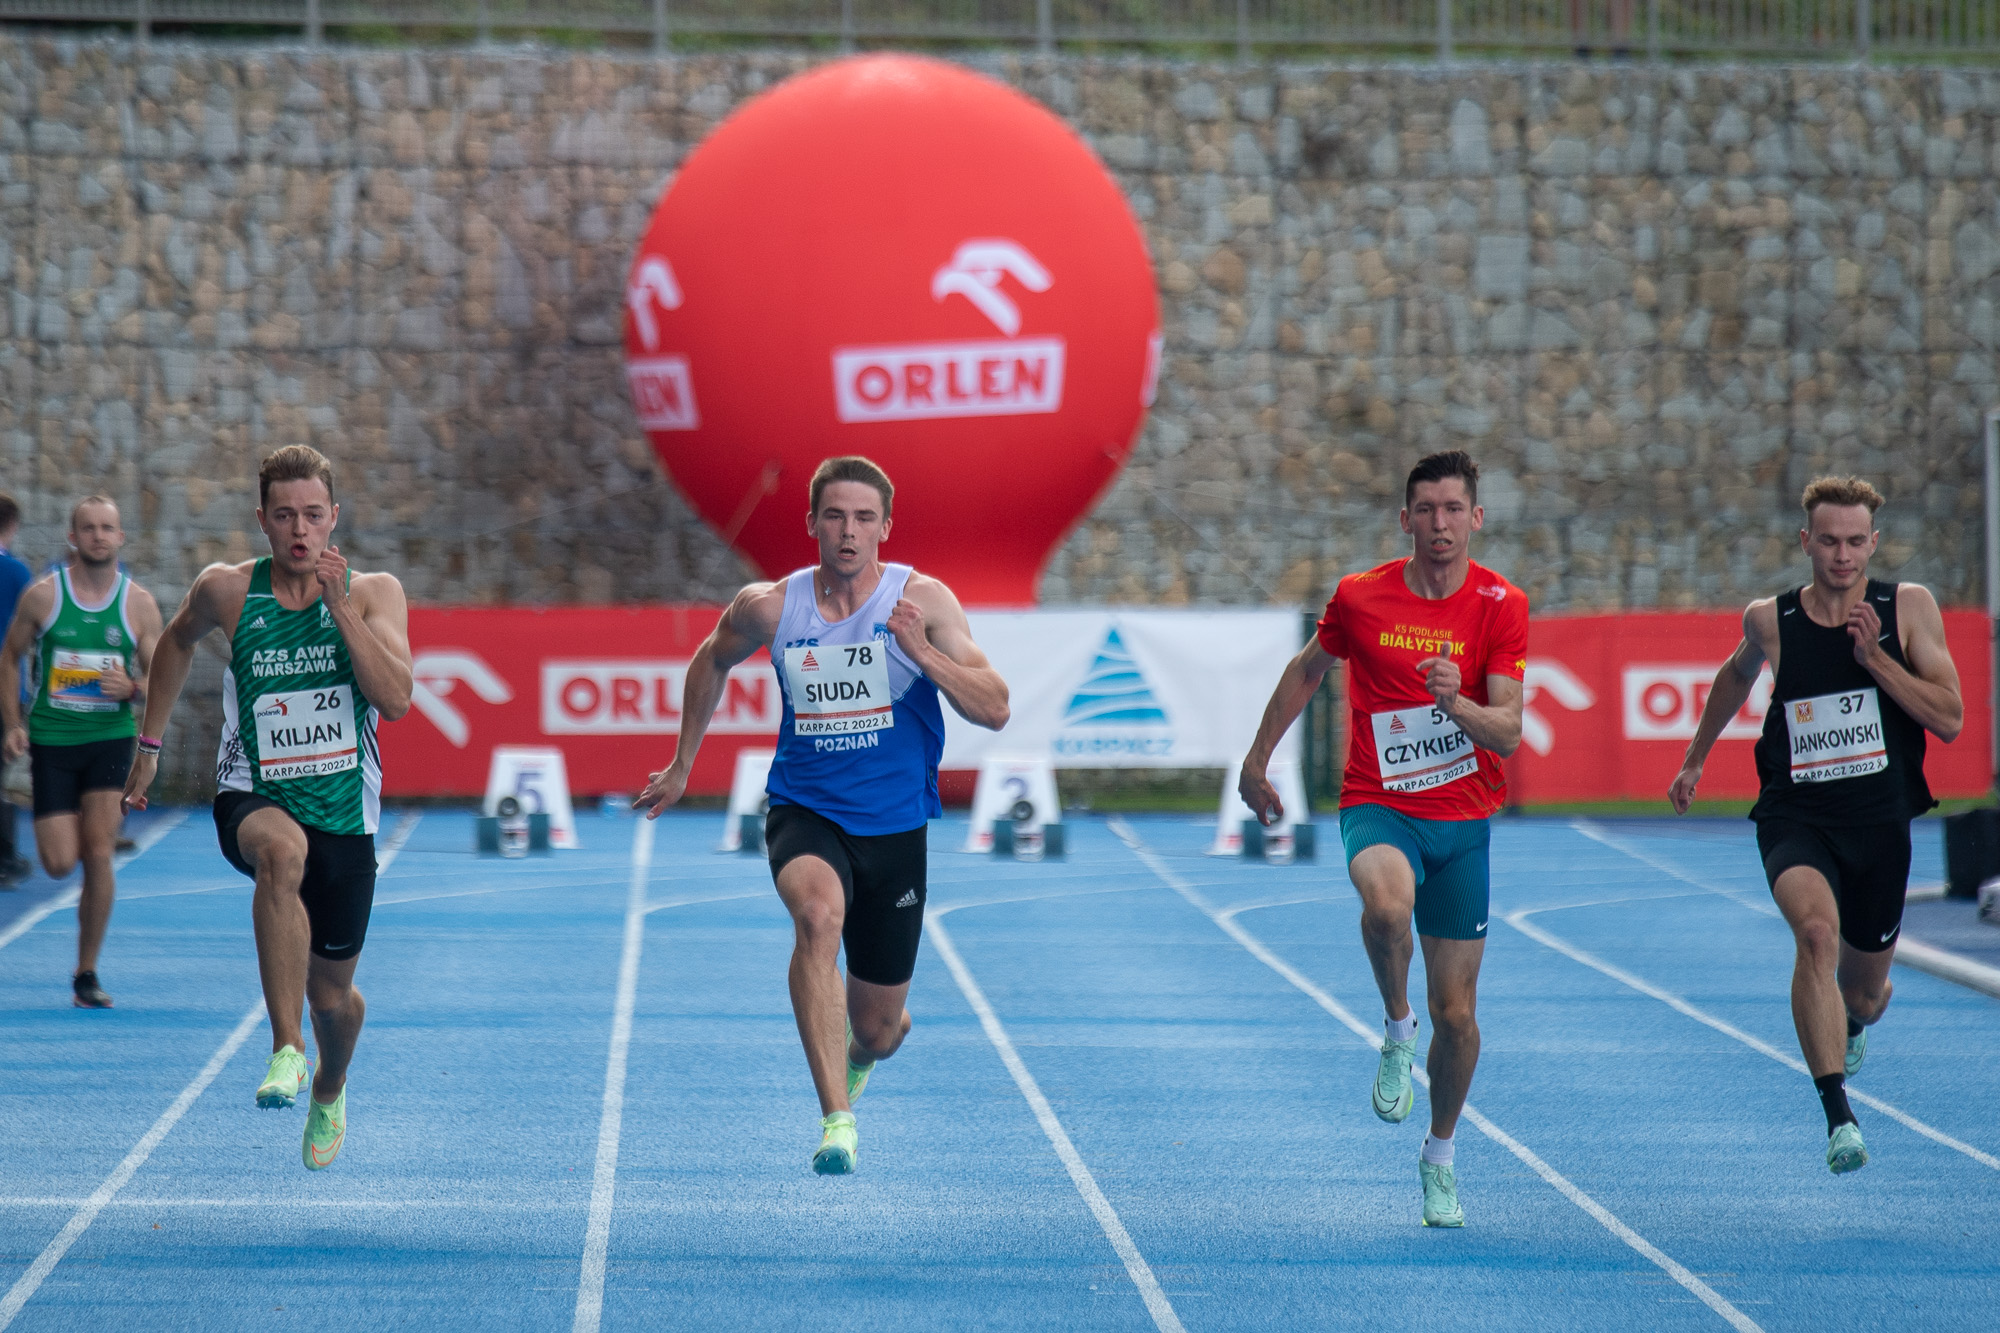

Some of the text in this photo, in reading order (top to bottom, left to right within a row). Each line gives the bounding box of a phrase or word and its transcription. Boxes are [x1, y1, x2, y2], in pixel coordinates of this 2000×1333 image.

[855, 358, 1049, 405] ORLEN
[1394, 624, 1453, 639] KS PODLASIE
[251, 645, 337, 664] AZS AWF
[844, 646, 873, 668] 78
[251, 659, 337, 678] WARSZAWA
[313, 690, 341, 712] 26
[562, 676, 768, 722] ORLN
[805, 680, 871, 704] SIUDA
[1839, 693, 1864, 715] 37
[799, 717, 879, 733] KARPACZ 2022
[1430, 708, 1452, 726] 5
[270, 722, 342, 748] KILJAN
[1794, 723, 1880, 755] JANKOWSKI
[1384, 730, 1466, 765] CZYKIER
[265, 759, 345, 778] KARPACZ 2022
[1388, 775, 1441, 792] KARPACZ
[1442, 765, 1465, 781] 2022
[1795, 761, 1875, 781] KARPACZ 2022
[895, 898, 919, 908] adidas
